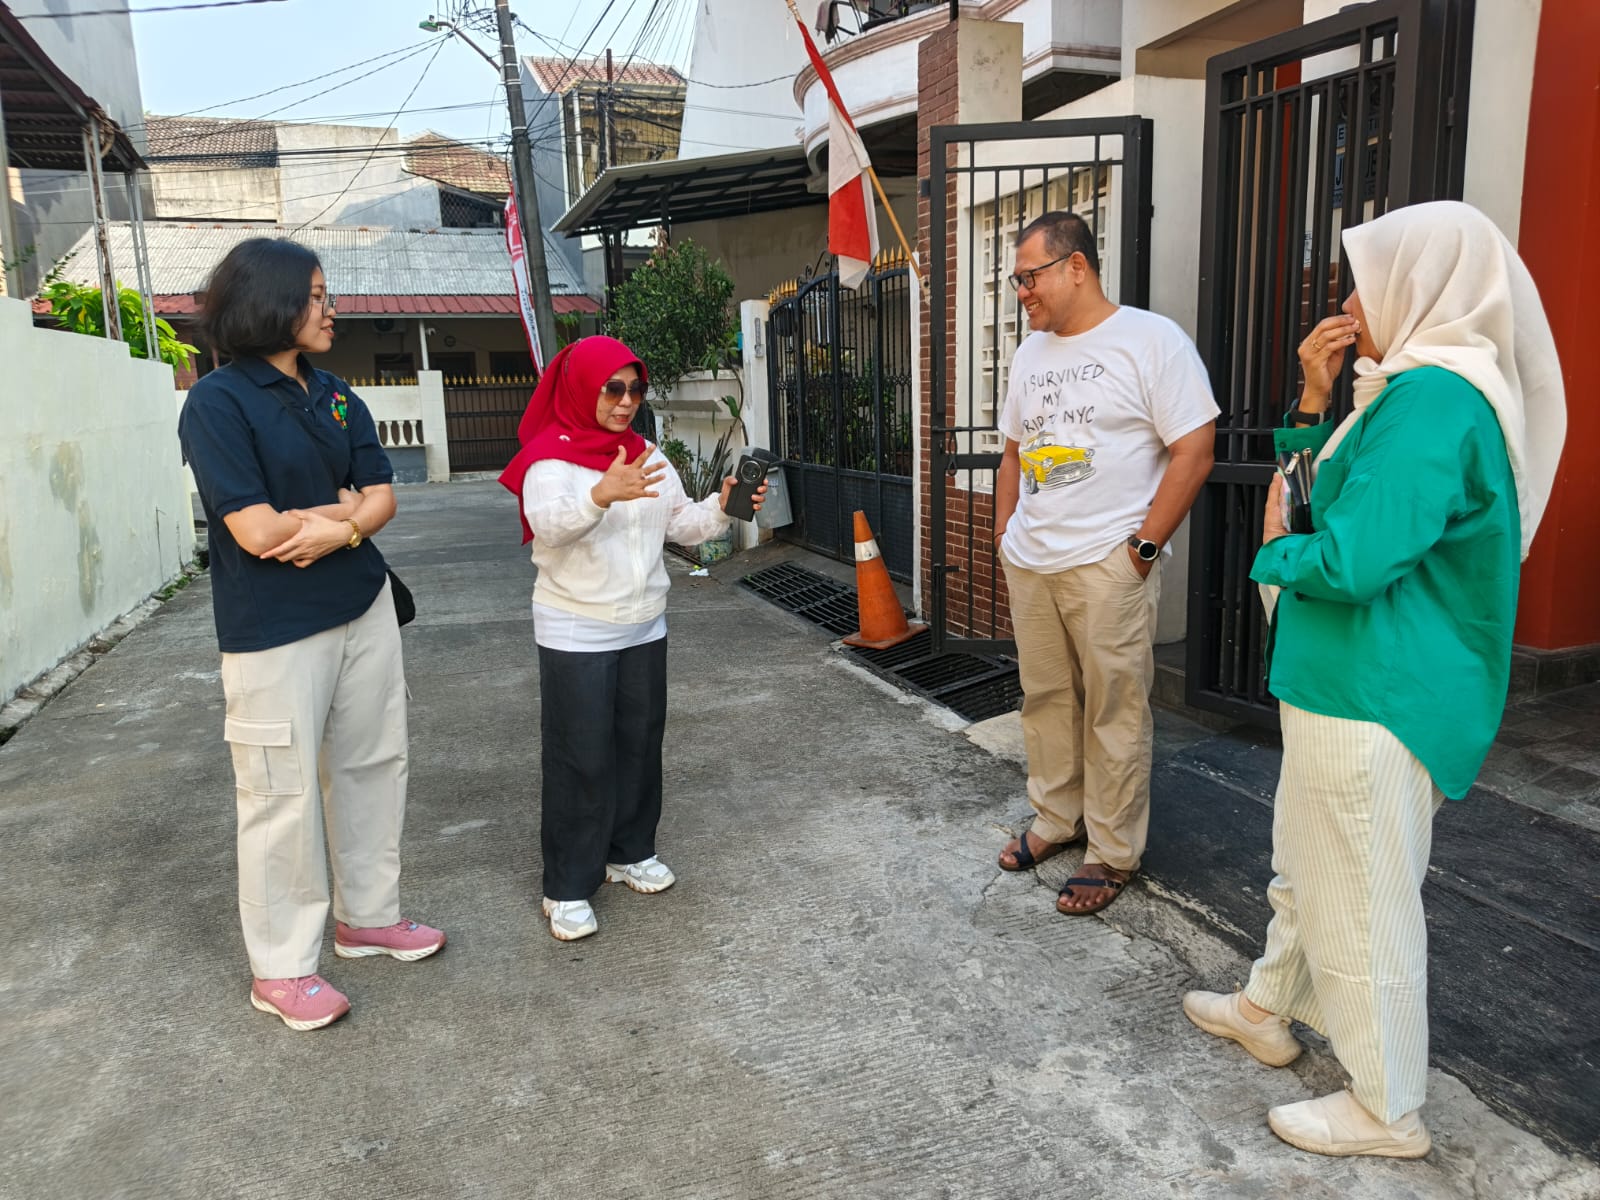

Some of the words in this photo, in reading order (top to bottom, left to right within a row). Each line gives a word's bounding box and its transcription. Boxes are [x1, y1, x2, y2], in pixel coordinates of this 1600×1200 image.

[1030, 363, 1105, 392] SURVIVED
[1042, 390, 1062, 408] MY
[1063, 406, 1095, 425] NYC
